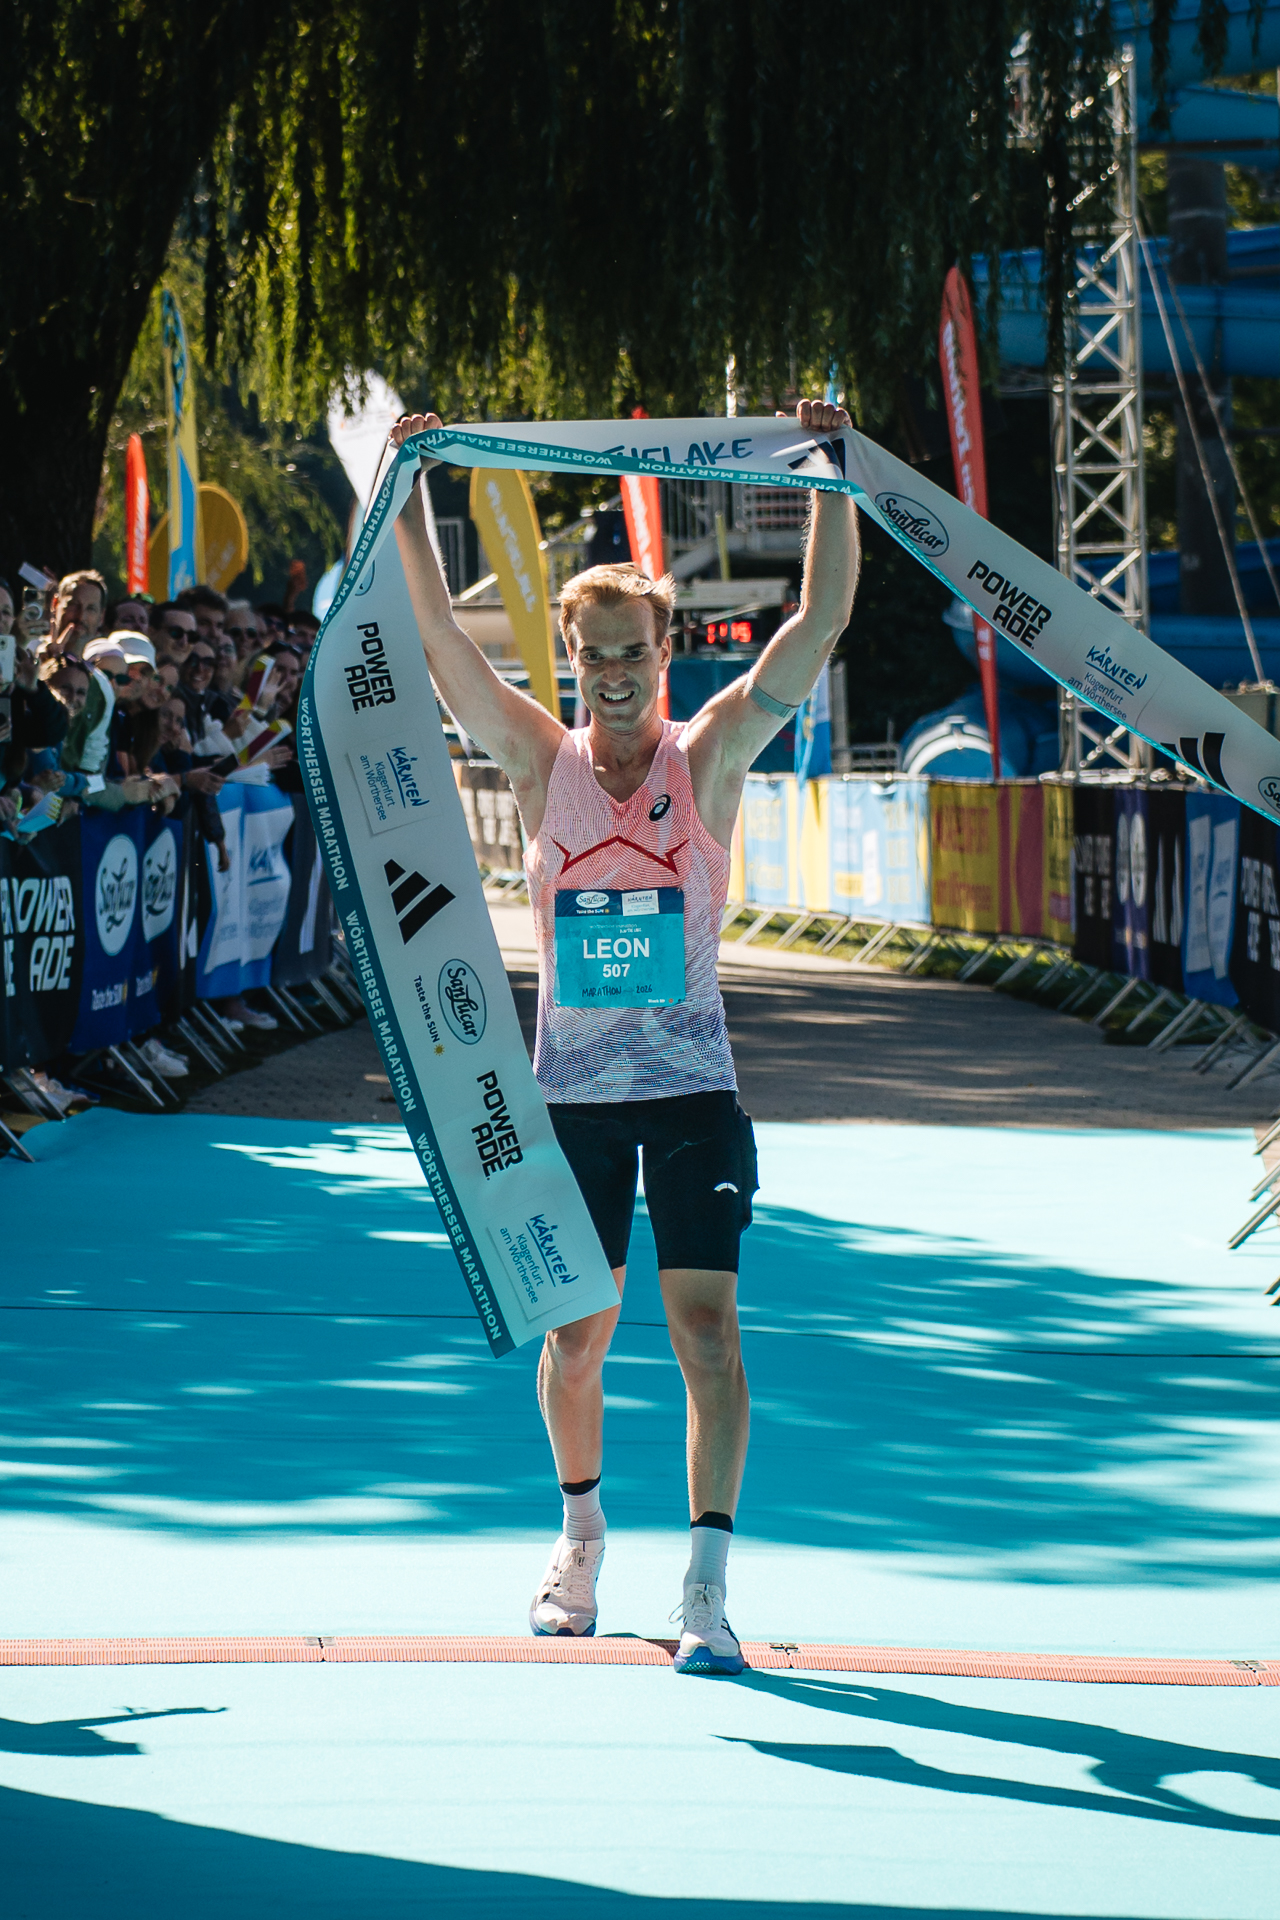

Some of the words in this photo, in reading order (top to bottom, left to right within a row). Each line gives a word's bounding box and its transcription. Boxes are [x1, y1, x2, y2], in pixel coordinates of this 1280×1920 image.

[496, 441, 613, 465] WÖRTHERSEE
[638, 461, 734, 479] MARATHON
[347, 471, 395, 580] WÖRTHERSEE
[966, 560, 1053, 630] POWER
[307, 583, 350, 672] MARATHON
[356, 621, 397, 707] POWER
[1084, 672, 1124, 705] Klagenfurt
[1068, 676, 1083, 690] am
[1083, 685, 1128, 721] Wörthersee
[360, 754, 371, 770] am
[375, 761, 396, 807] Klagenfurt
[300, 697, 328, 805] WÖRTHERSEE
[317, 806, 349, 890] MARATHON
[365, 771, 387, 821] Wörthersee
[583, 938, 650, 959] LEON
[602, 963, 631, 978] 507
[345, 910, 386, 1020] WÖRTHERSEE
[378, 1020, 416, 1113] MARATHON
[414, 975, 426, 1002] Taste
[422, 1003, 432, 1021] the
[427, 1021, 441, 1043] SUN
[445, 967, 479, 1037] SanLucar
[581, 985, 622, 998] MARATHON
[636, 984, 653, 994] 2026
[476, 1070, 524, 1169] POWER
[416, 1132, 465, 1246] WÖRTHERSEE
[460, 1247, 502, 1341] MARATHON
[500, 1227, 512, 1245] am
[509, 1244, 539, 1304] Wörthersee
[516, 1233, 545, 1287] Klagenfurt
